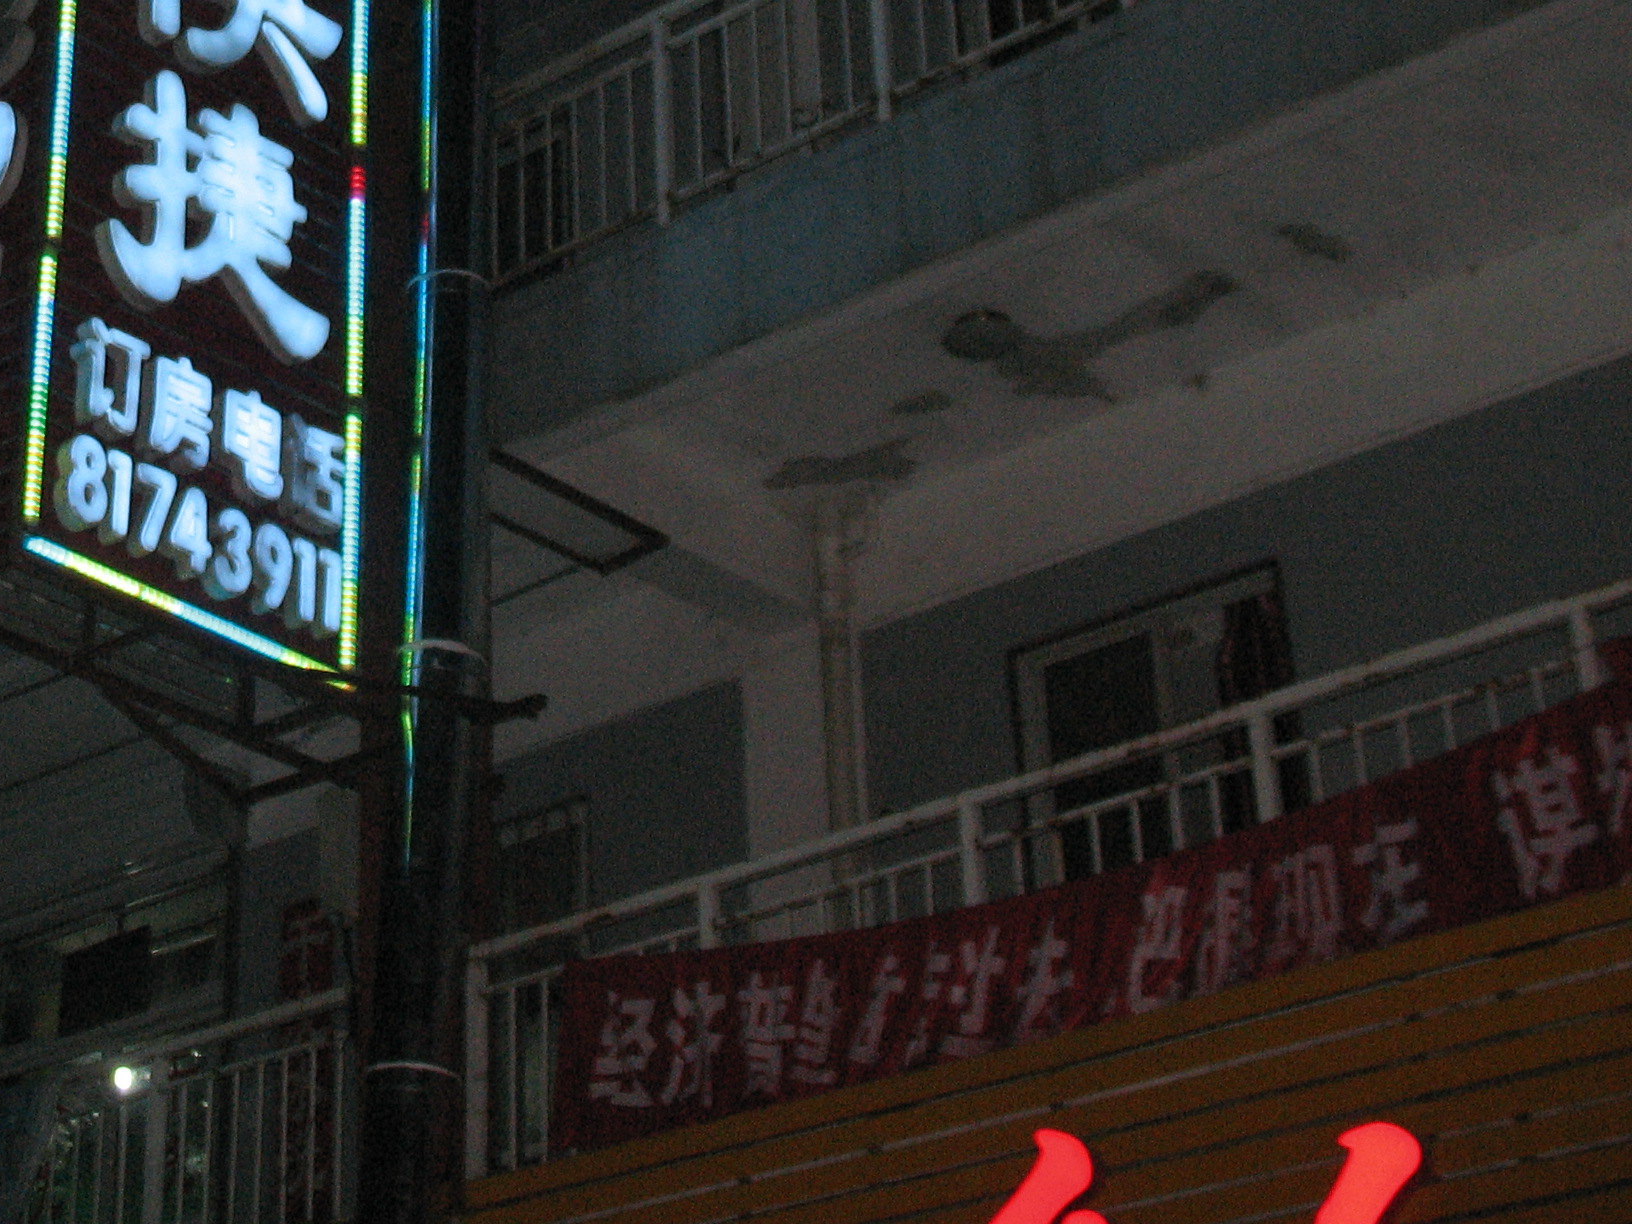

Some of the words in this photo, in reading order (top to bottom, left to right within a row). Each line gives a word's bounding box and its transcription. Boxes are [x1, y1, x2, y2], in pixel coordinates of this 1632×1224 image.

[73, 316, 346, 532] 订房电话
[60, 432, 344, 634] 81743911
